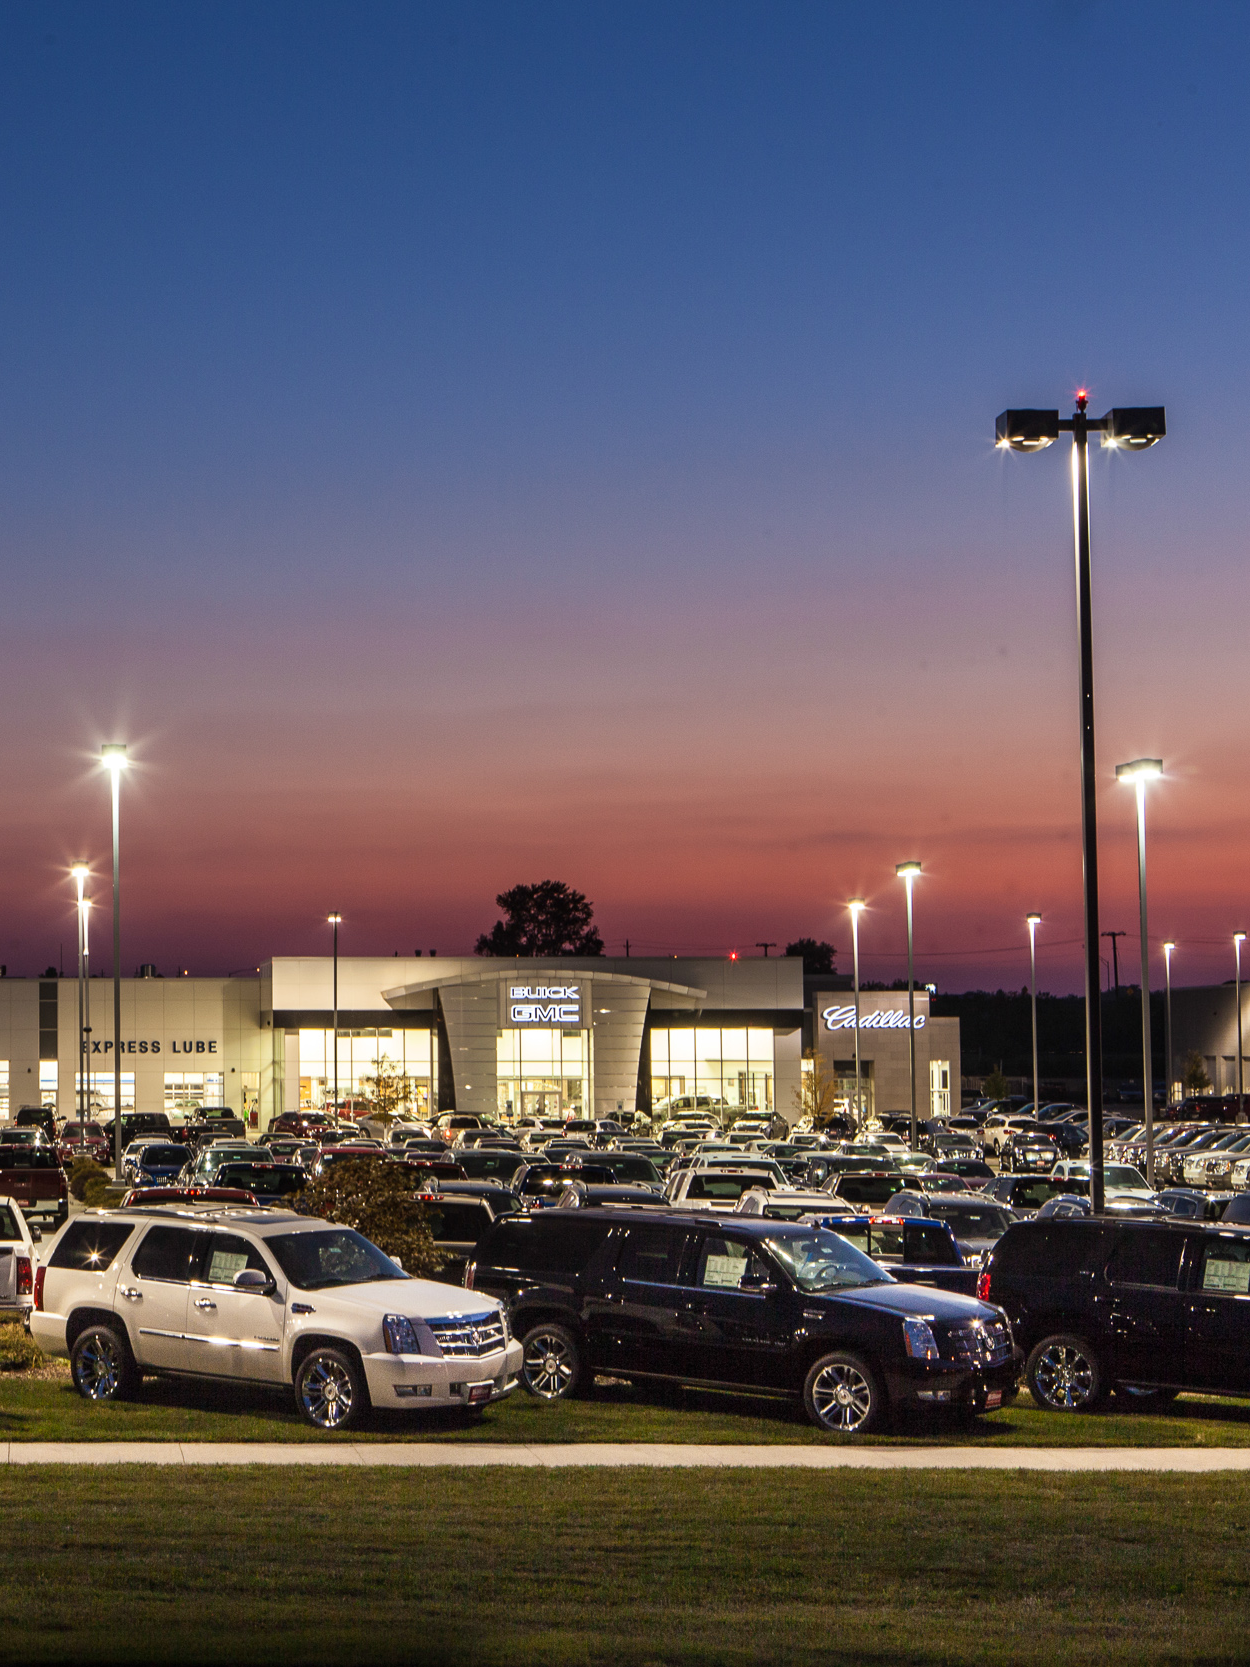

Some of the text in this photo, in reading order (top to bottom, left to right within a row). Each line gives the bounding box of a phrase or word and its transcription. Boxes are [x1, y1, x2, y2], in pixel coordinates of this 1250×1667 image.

[510, 986, 580, 1000] BUICK
[511, 1004, 580, 1022] GMC
[822, 1005, 926, 1031] Cadillac
[172, 1040, 218, 1054] LUBE
